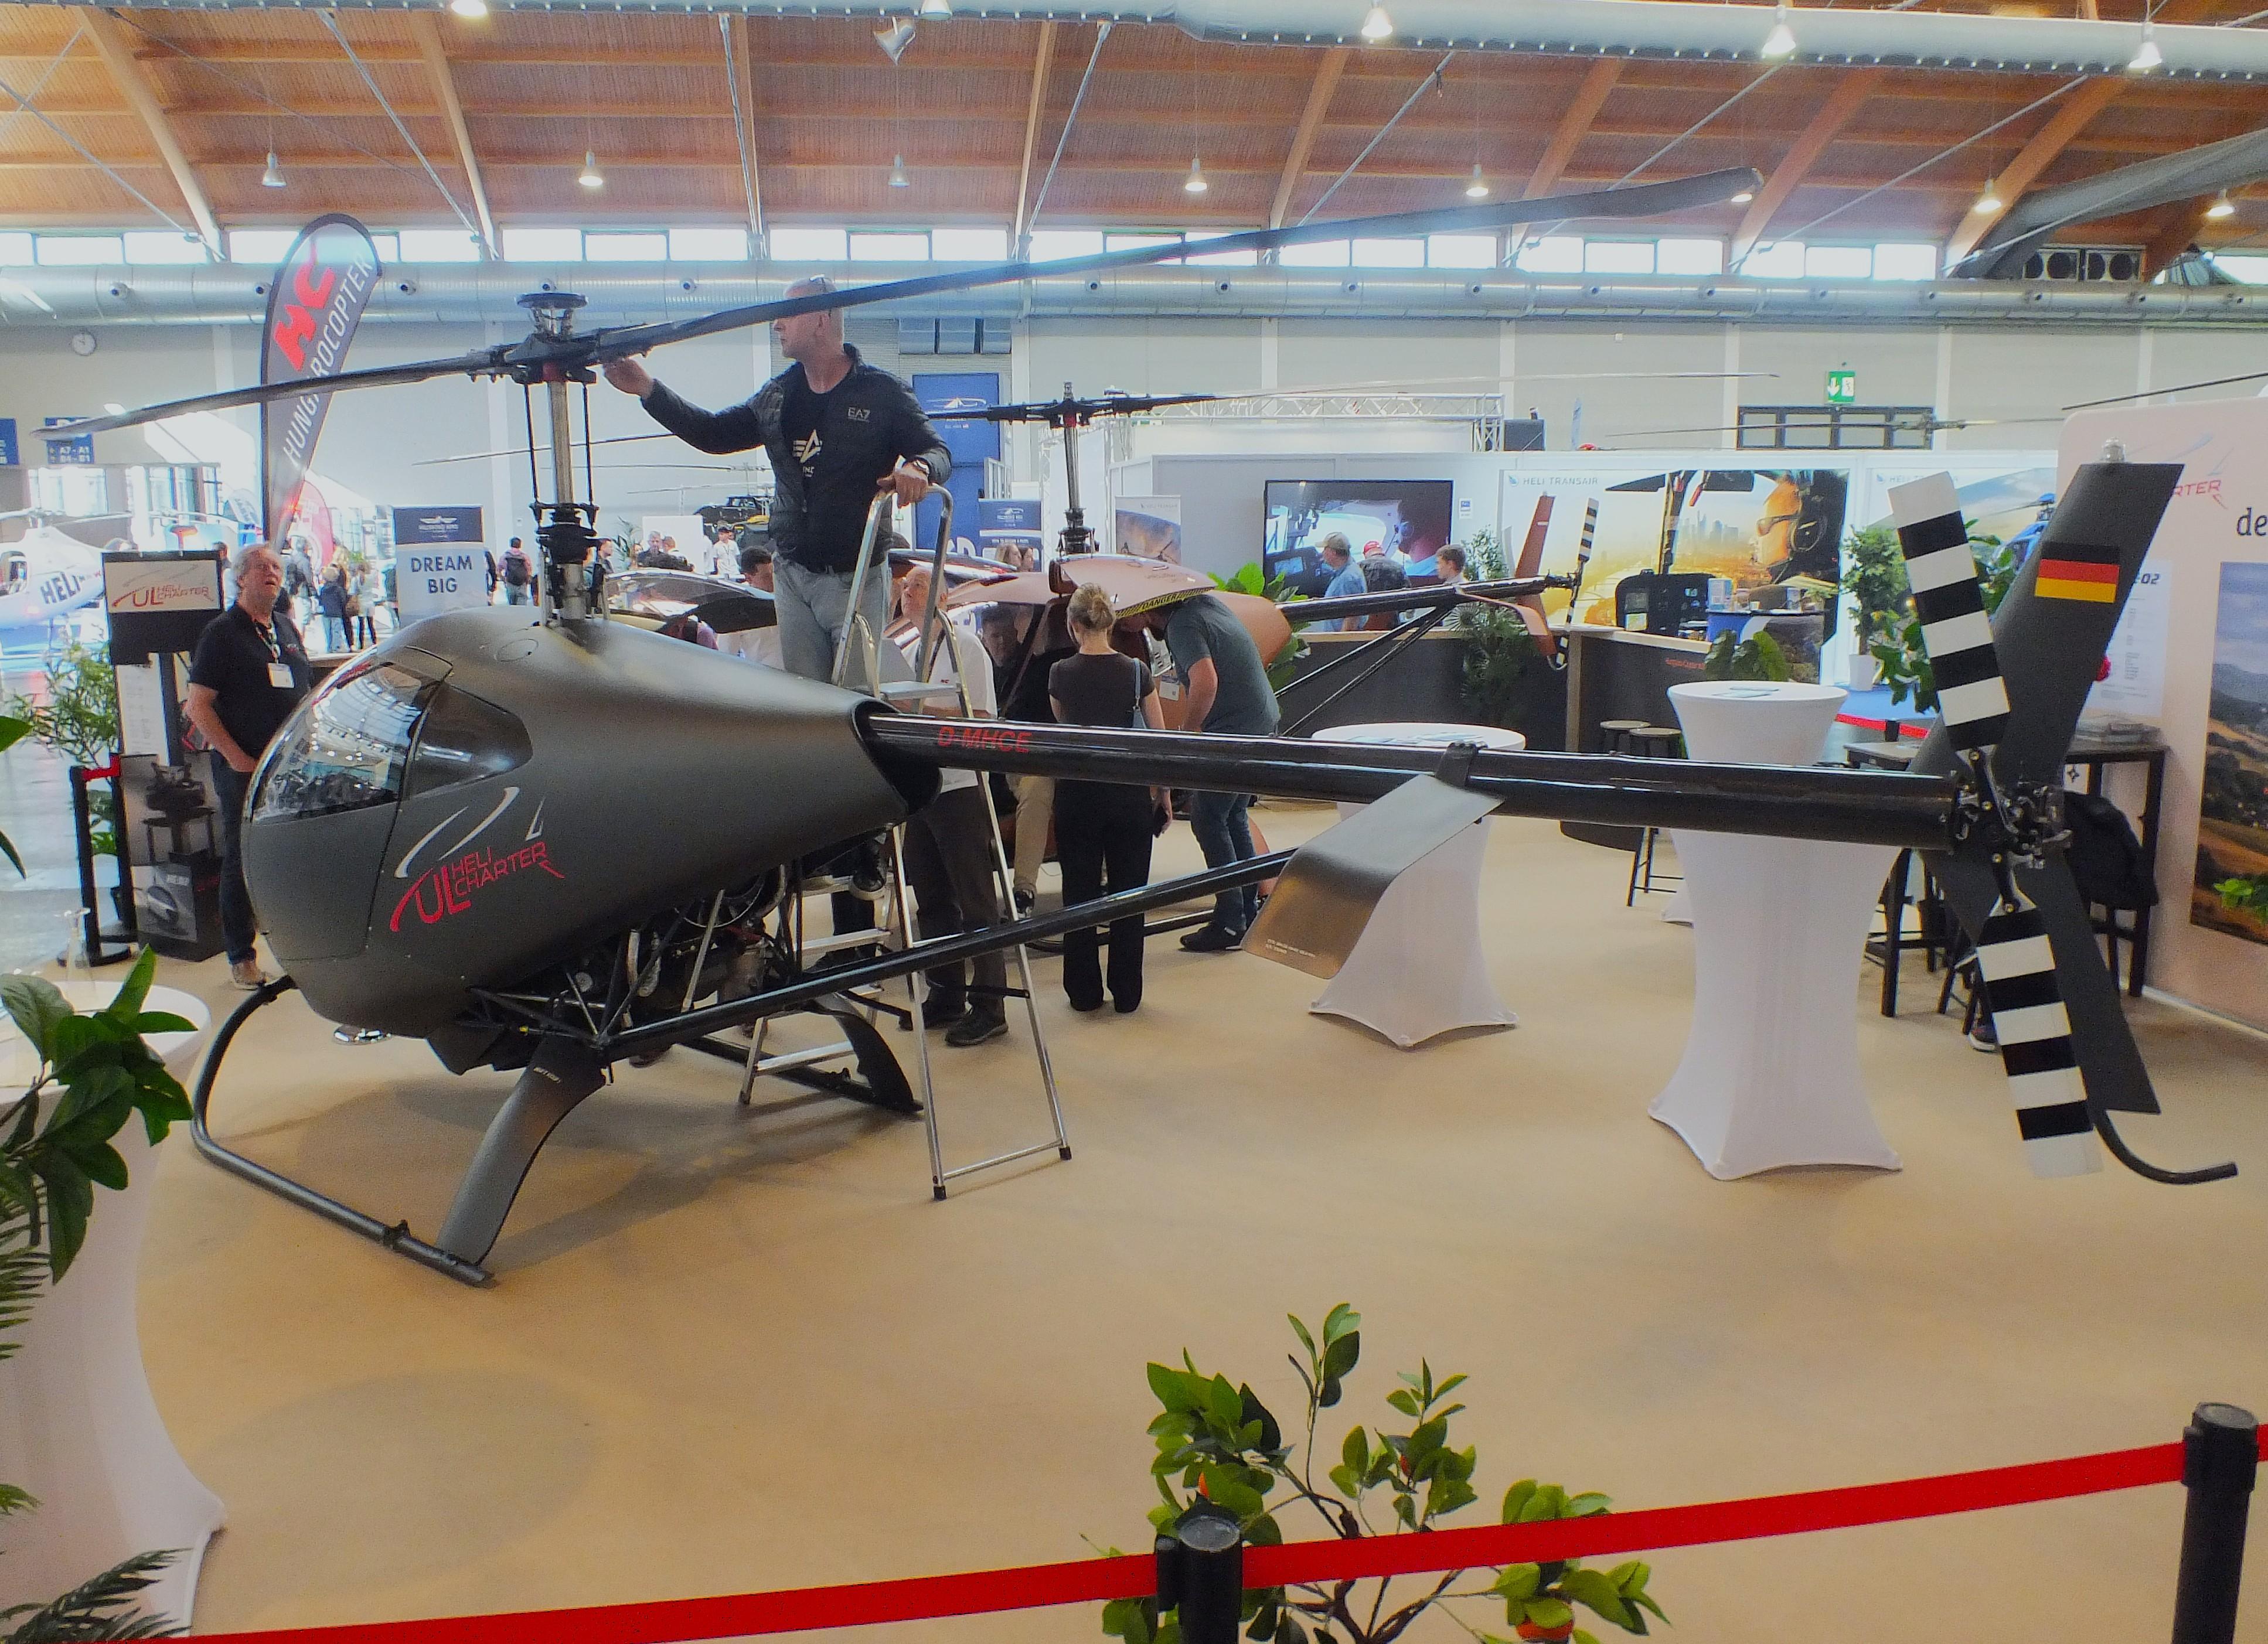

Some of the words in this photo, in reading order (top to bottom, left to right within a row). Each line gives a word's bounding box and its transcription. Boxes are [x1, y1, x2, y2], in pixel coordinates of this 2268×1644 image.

[848, 407, 870, 419] EA7
[1550, 477, 1598, 485] TRANSAIR
[2173, 480, 2221, 497] RTER
[411, 555, 472, 572] DREAM
[428, 578, 458, 594] BIG
[1142, 594, 1177, 610] DANGER
[451, 846, 493, 878] HELI
[415, 865, 472, 924] UL
[454, 841, 548, 896] CHARTER
